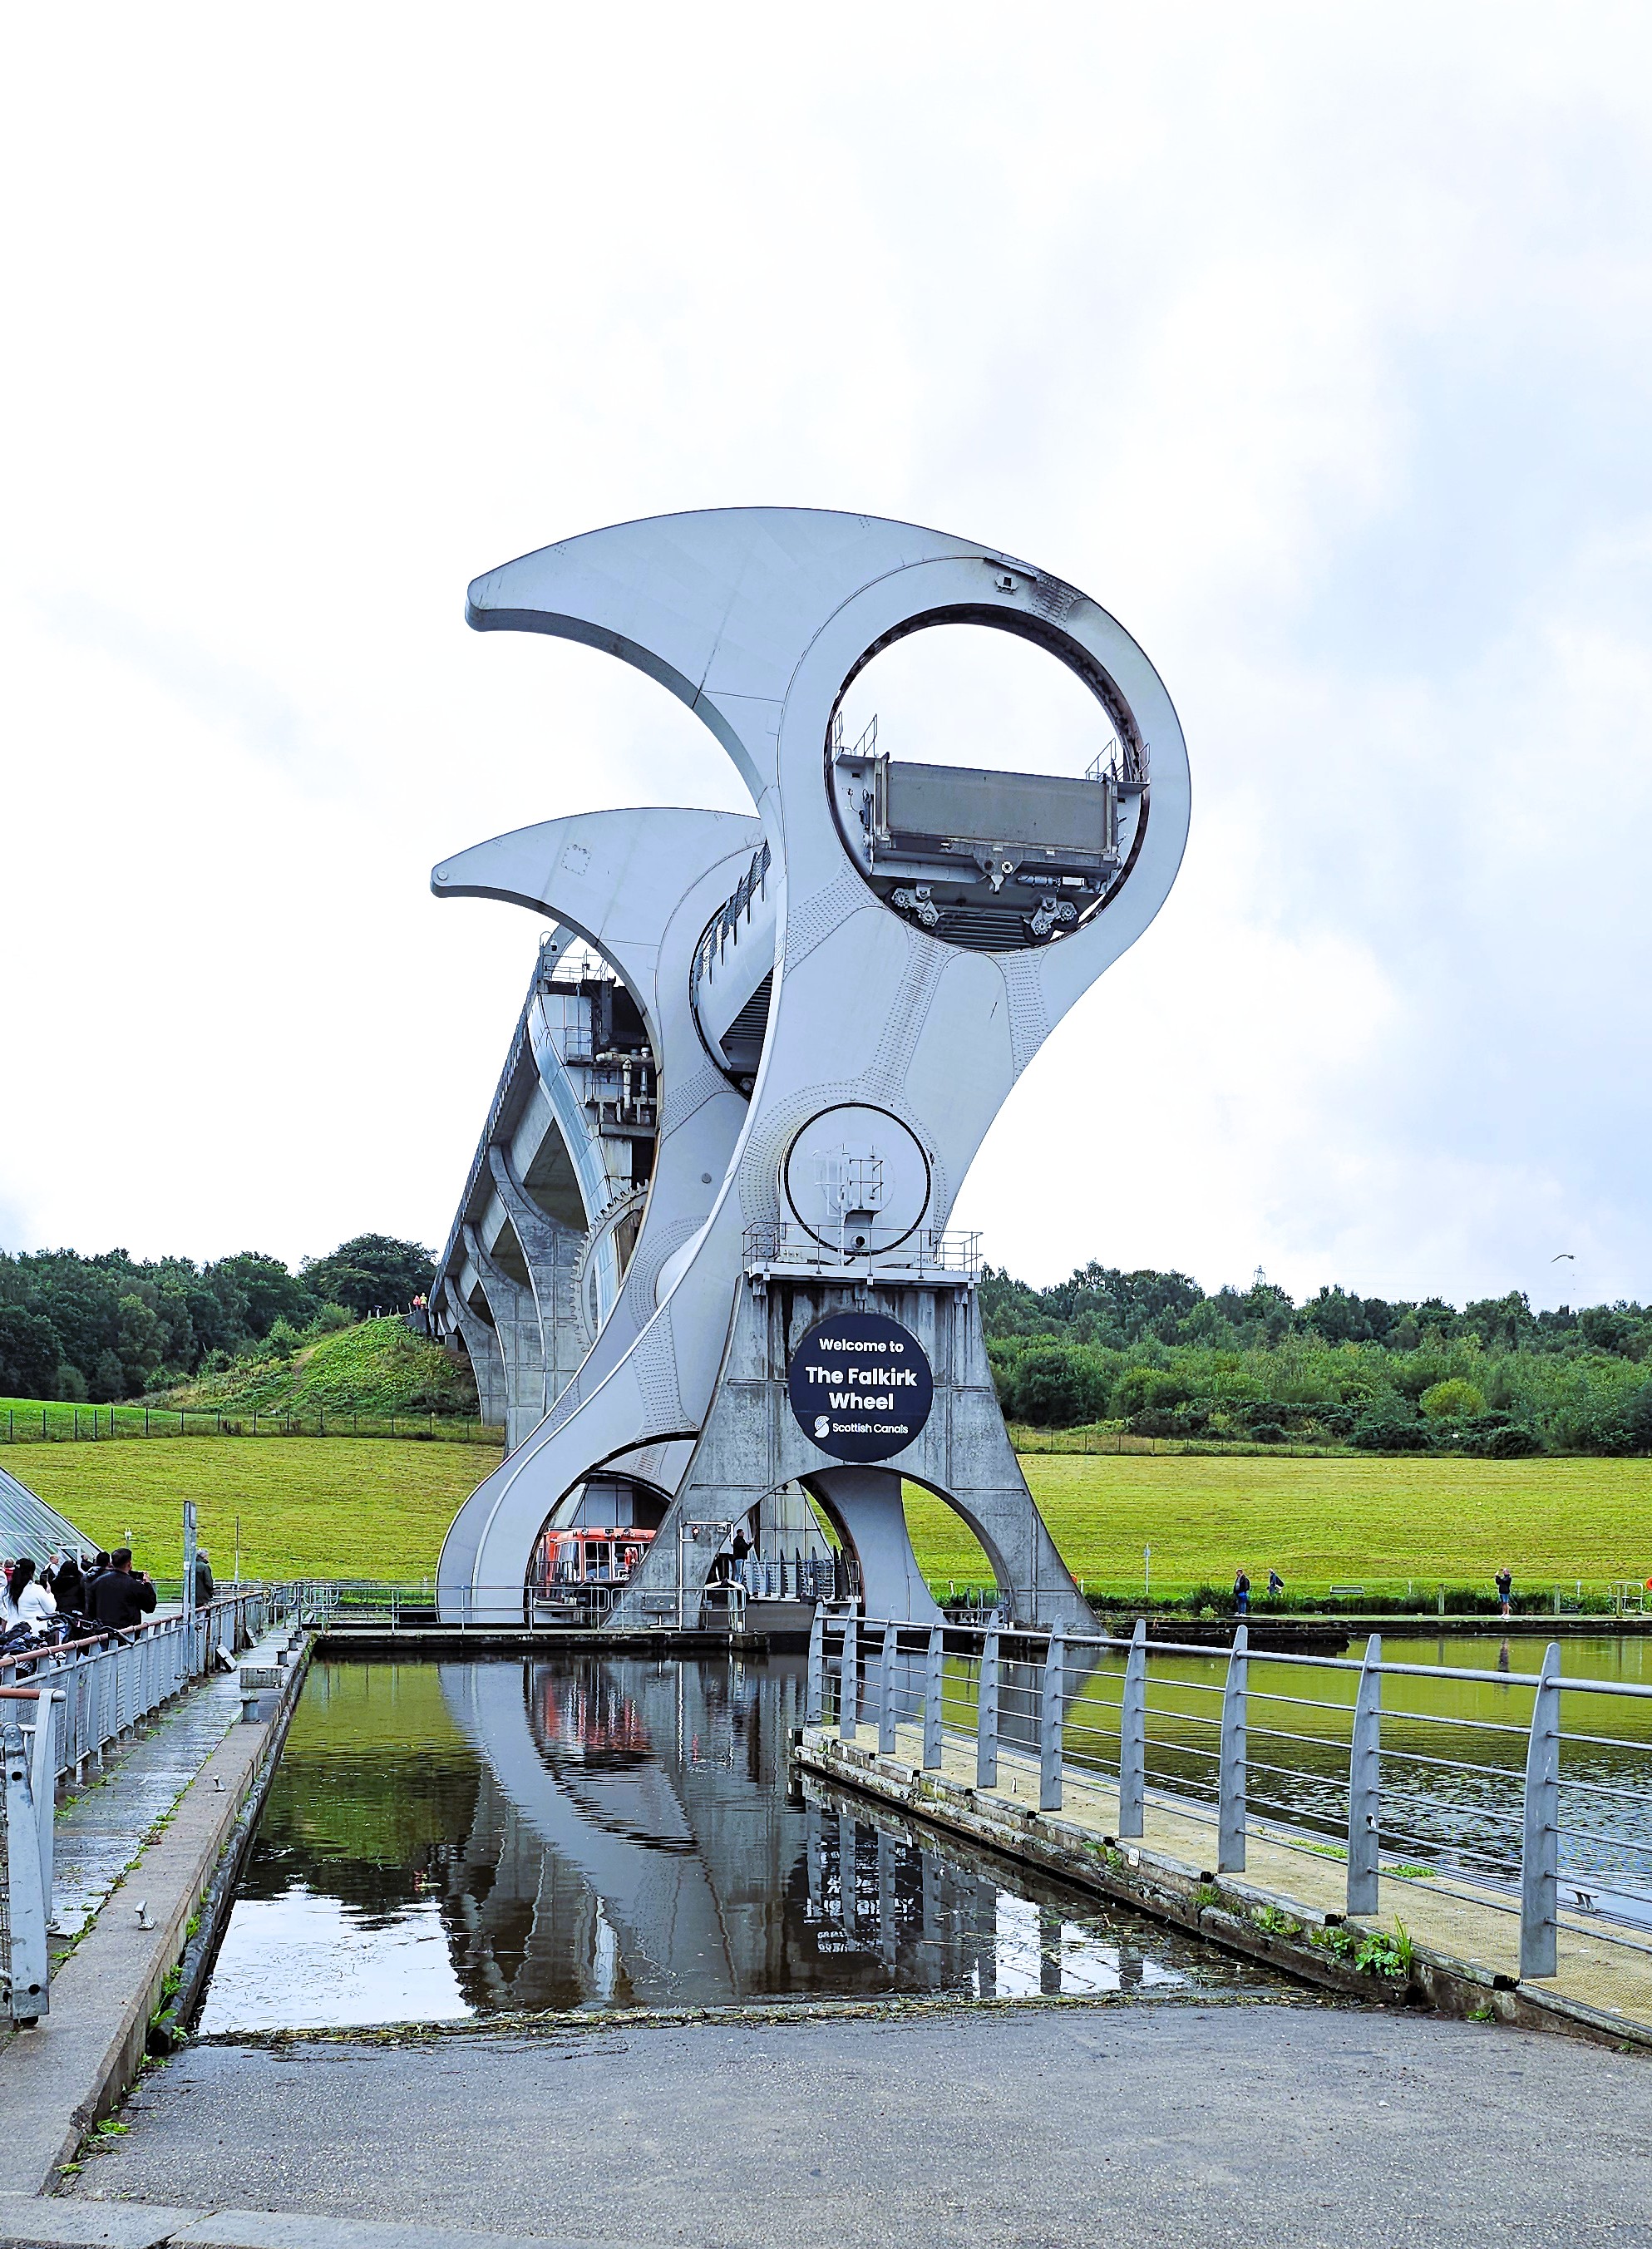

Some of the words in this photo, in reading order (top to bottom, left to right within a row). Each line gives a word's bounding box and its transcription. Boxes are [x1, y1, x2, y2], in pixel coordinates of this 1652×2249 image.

[819, 1338, 886, 1353] Welcome
[889, 1340, 905, 1353] to
[805, 1366, 844, 1384] The
[848, 1367, 918, 1387] Falkirk
[828, 1392, 894, 1410] Wheel
[832, 1423, 872, 1433] Scottish
[873, 1423, 909, 1434] Canals
